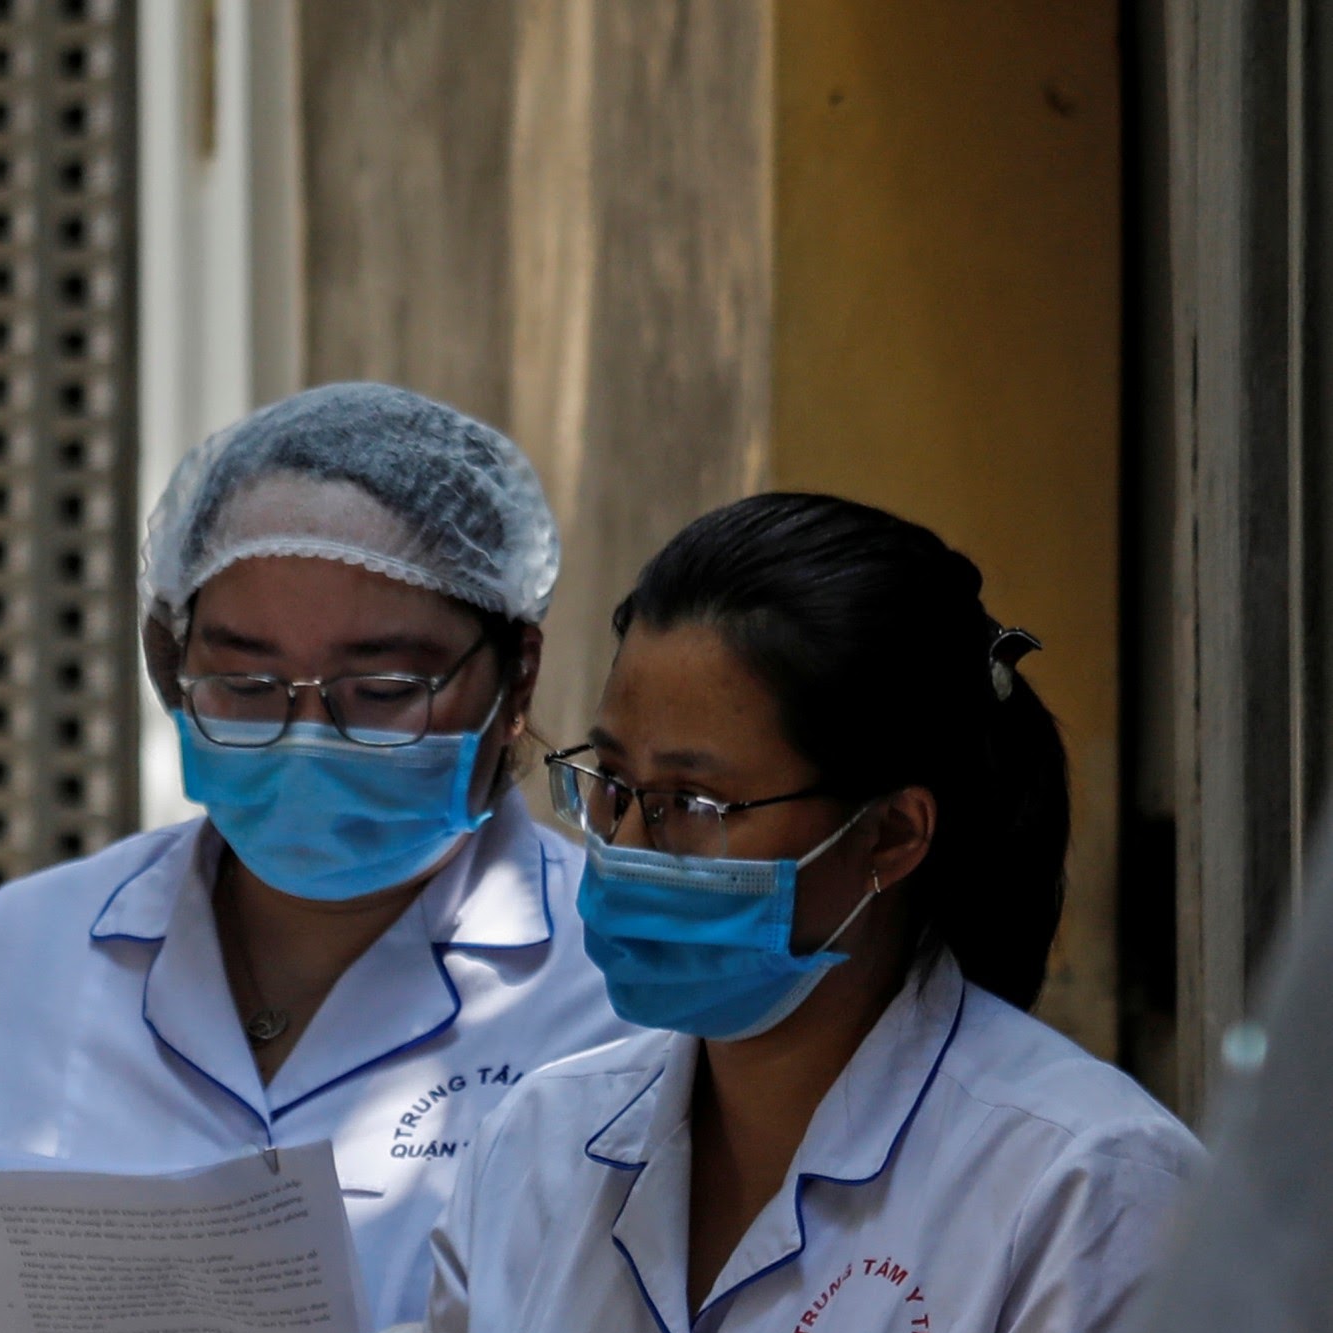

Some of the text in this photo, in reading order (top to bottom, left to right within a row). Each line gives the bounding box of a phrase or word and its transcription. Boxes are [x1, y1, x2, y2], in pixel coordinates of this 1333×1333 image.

[393, 1064, 524, 1141] TRUNG TÂ
[863, 1257, 909, 1287] TÂM
[905, 1286, 925, 1304] Y
